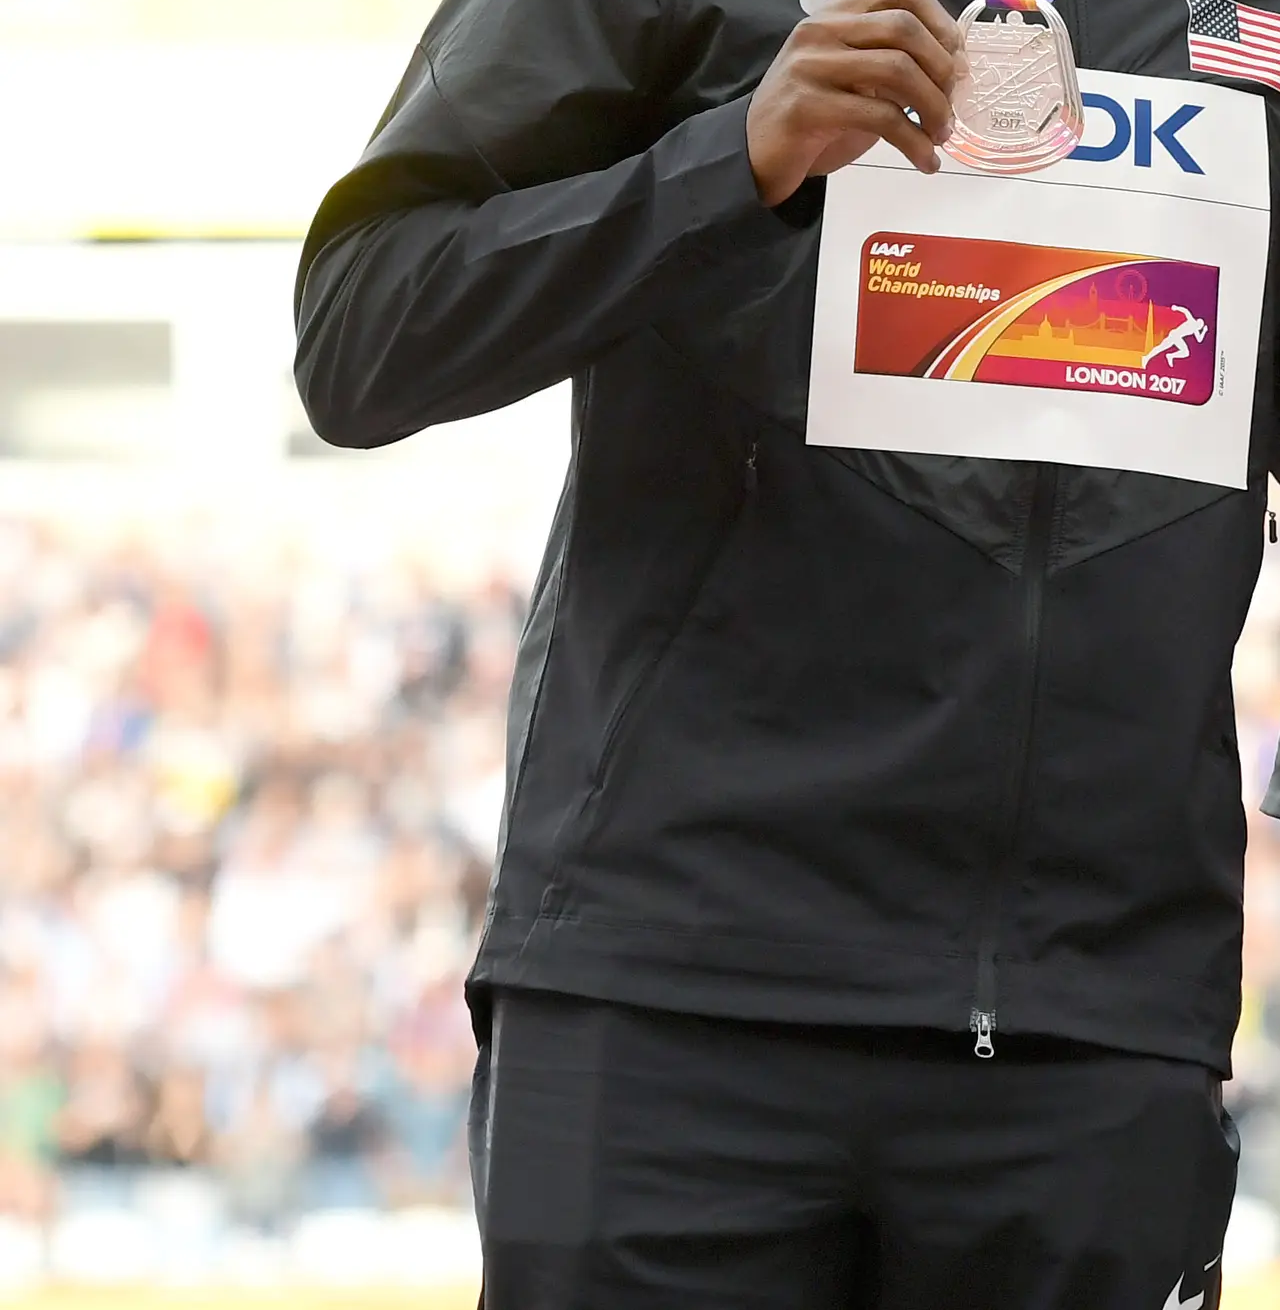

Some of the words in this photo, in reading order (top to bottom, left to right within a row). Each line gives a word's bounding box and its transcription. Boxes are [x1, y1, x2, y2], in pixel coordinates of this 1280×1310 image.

[991, 118, 1022, 129] 2017
[869, 242, 914, 257] IAAF
[868, 259, 920, 278] World
[867, 276, 1001, 302] Championships
[1065, 366, 1147, 391] LONDON
[1148, 375, 1187, 396] 2017
